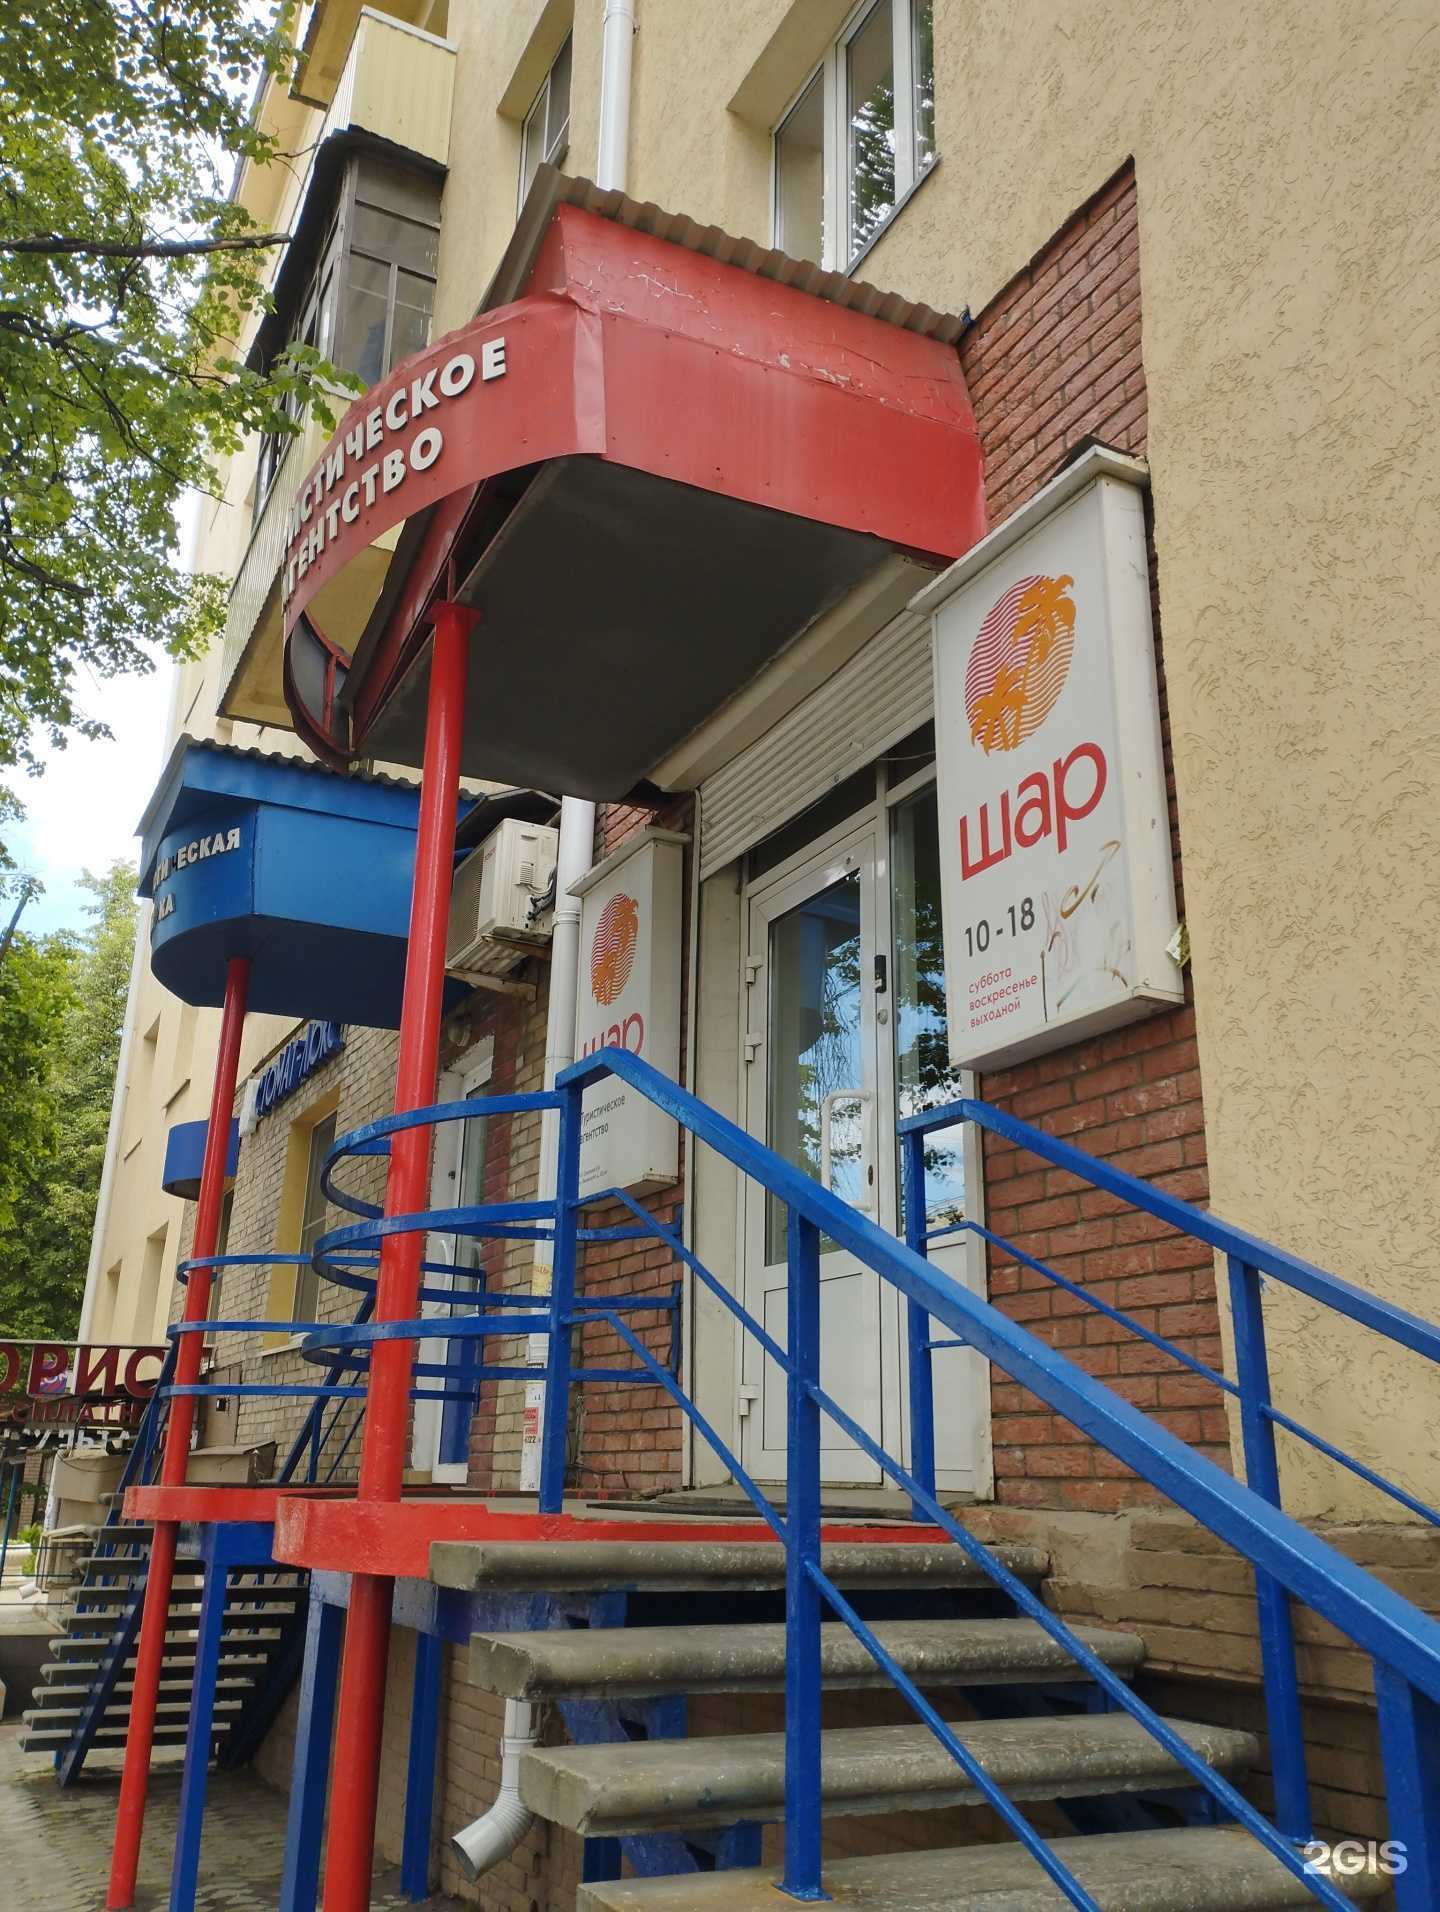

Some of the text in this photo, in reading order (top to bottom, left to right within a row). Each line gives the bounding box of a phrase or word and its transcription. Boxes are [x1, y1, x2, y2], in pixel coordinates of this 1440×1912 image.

[282, 336, 508, 560] ИСТИЧЕСКОЕ
[282, 427, 443, 606] ГЕНТСТВО
[968, 967, 1012, 994] суббота
[969, 974, 1038, 1011] воскресенье
[970, 996, 1021, 1028] выходной
